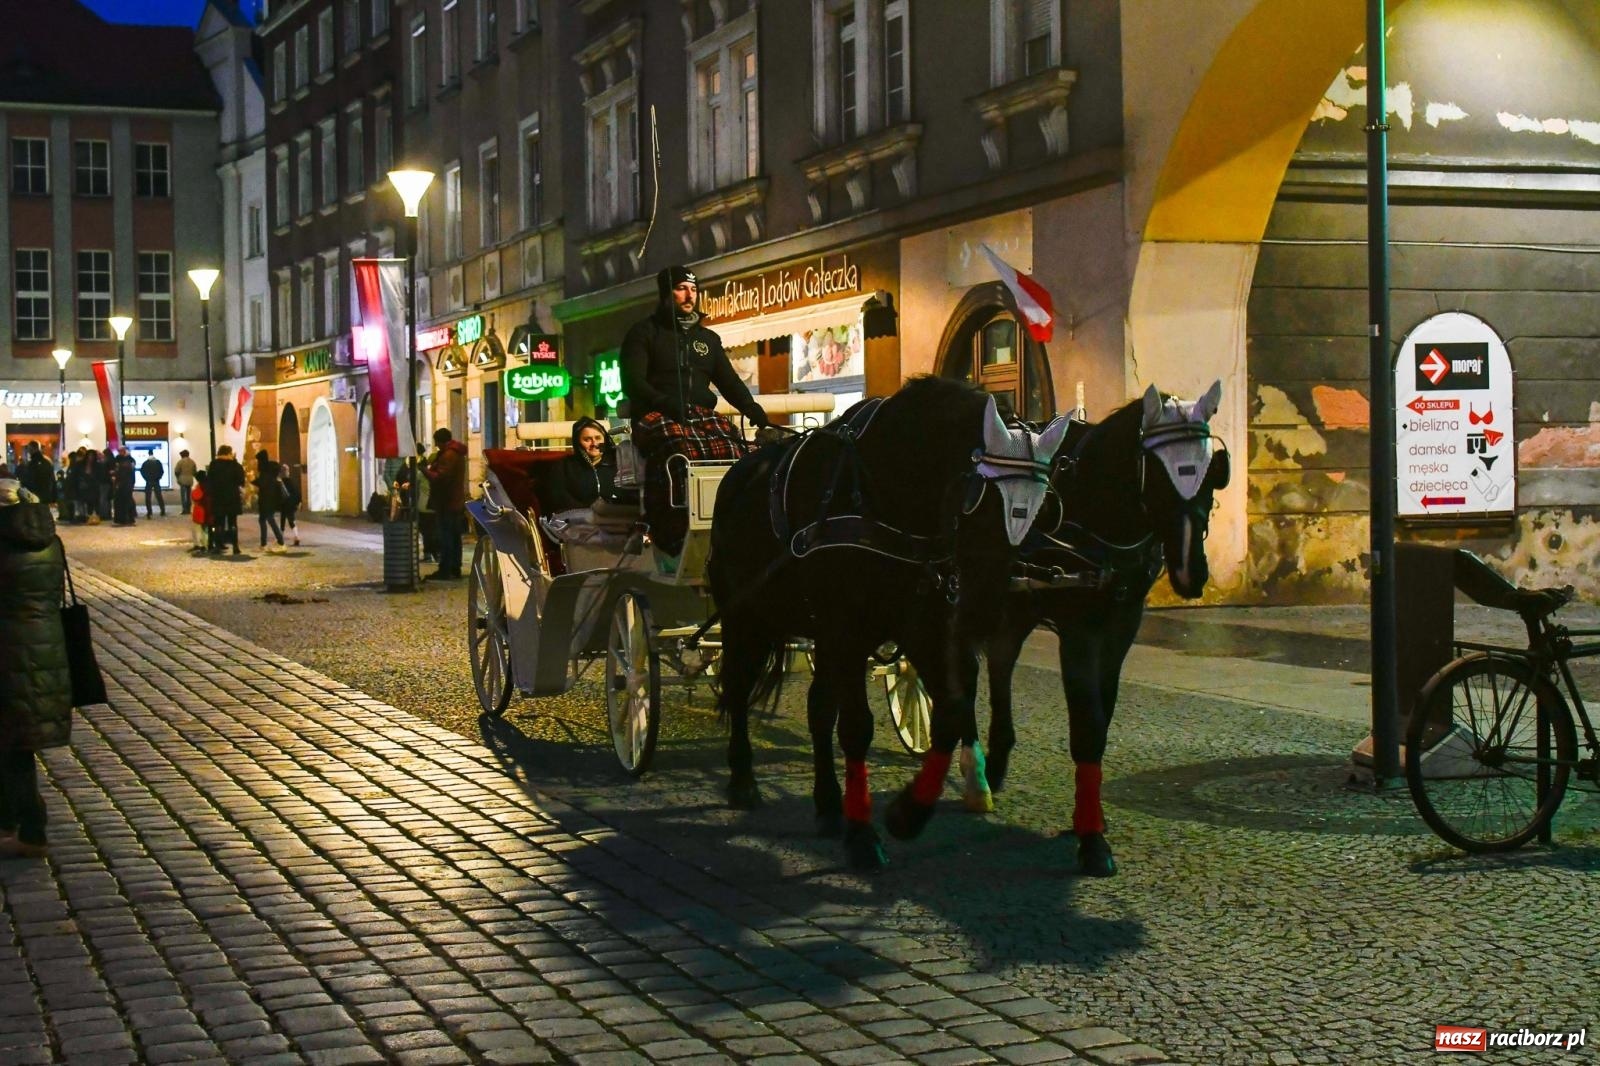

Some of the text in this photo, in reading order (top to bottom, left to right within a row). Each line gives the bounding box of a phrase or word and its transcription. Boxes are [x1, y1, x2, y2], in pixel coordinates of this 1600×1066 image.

[699, 254, 858, 320] Manufaktura Lodów Gałeczka
[532, 351, 556, 359] TYSKIE
[1452, 356, 1484, 375] moraj
[512, 372, 564, 389] żabka
[1427, 401, 1454, 409] SKLEPU
[124, 427, 157, 436] REBRO
[1409, 419, 1459, 432] bielizna
[1409, 443, 1457, 456] damska
[1409, 462, 1449, 476] męska
[1409, 480, 1468, 494] dziecięca
